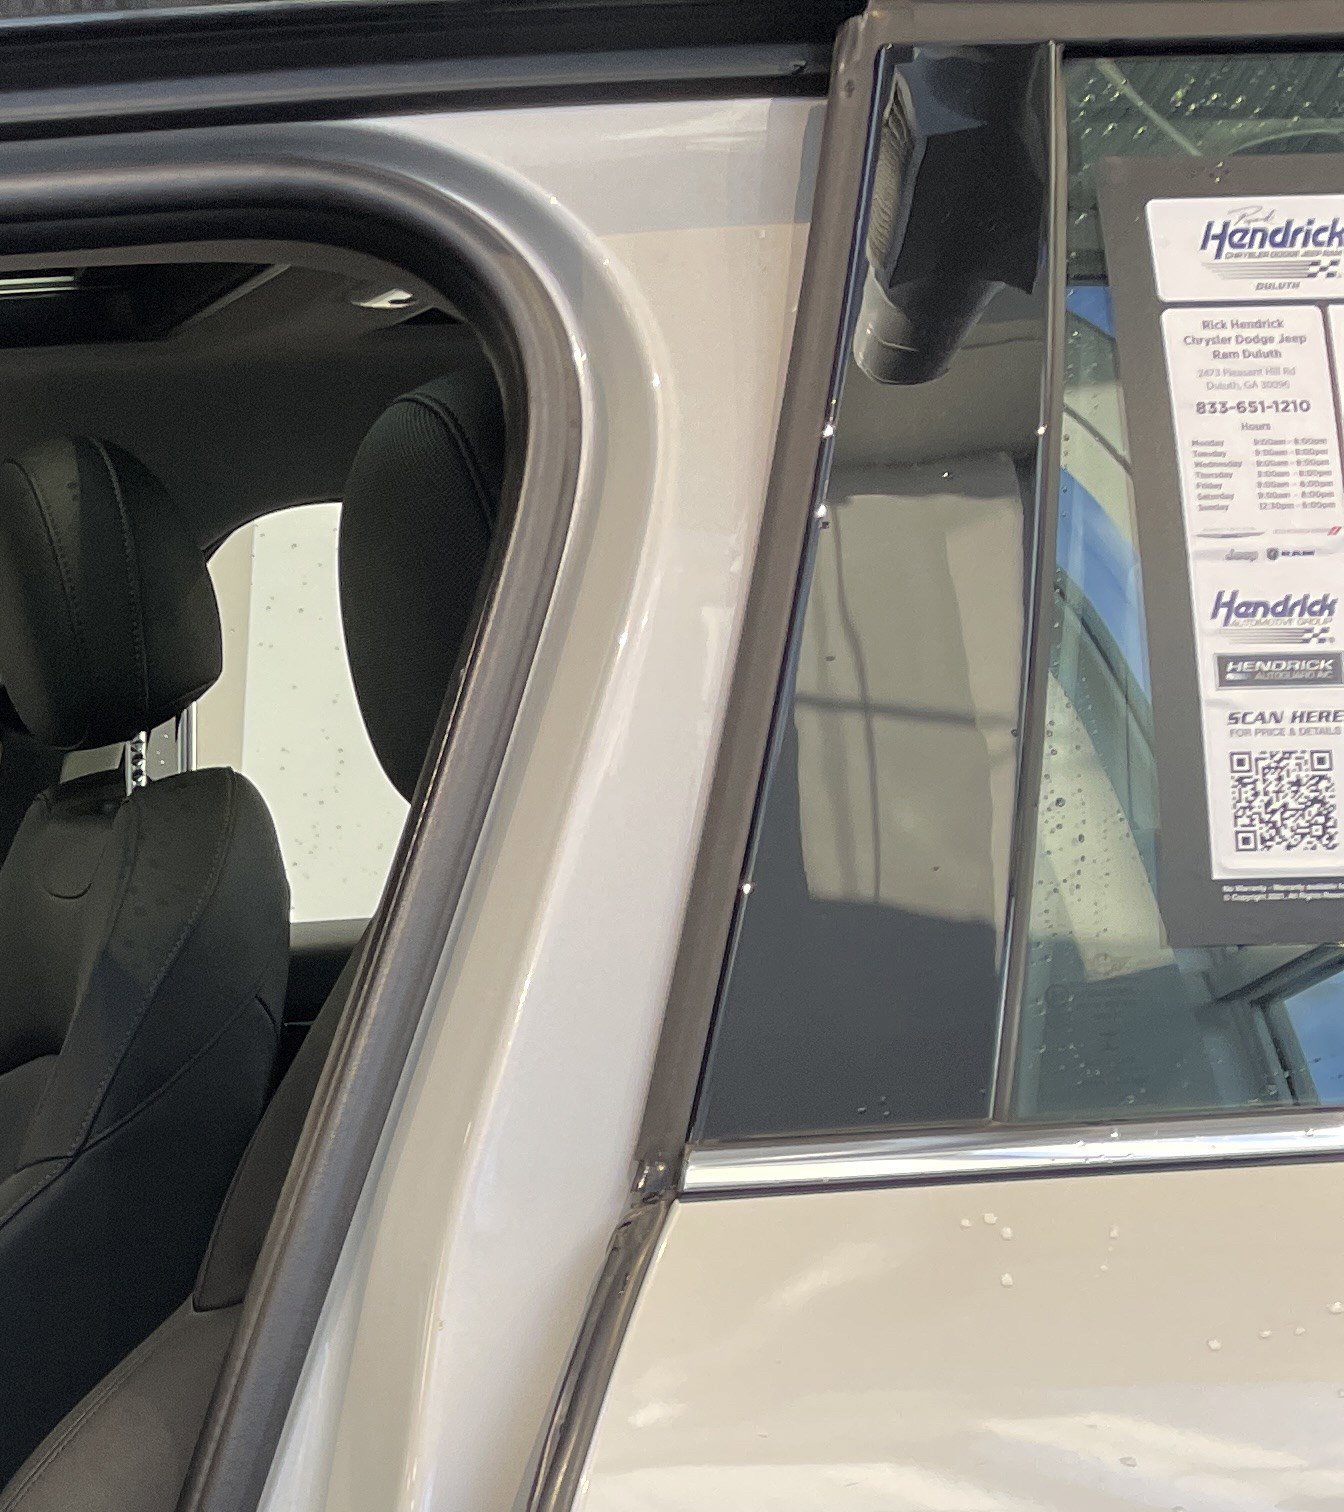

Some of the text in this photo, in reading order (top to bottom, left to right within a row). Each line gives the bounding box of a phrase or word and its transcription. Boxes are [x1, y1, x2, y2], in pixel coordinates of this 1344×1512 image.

[1199, 217, 1344, 260] Hendrick
[1255, 281, 1301, 291] DULUTH
[1202, 319, 1284, 330] Rick Hendrick
[1183, 333, 1307, 346] Chrysler Dodge Jeep
[1212, 349, 1282, 359] Ram Duluth
[1265, 367, 1280, 376] Hill
[1282, 367, 1296, 376] Rd
[1243, 381, 1259, 389] GA
[1196, 400, 1312, 415] 833-651-1210
[1240, 422, 1271, 431] Hours
[1210, 589, 1339, 627] Hendrick
[1226, 659, 1334, 672] HENDRICK
[1227, 710, 1344, 725] SCAN HERE
[1230, 728, 1252, 737] FOR
[1255, 728, 1286, 737] PRICE
[1298, 726, 1342, 736] DETAILS
